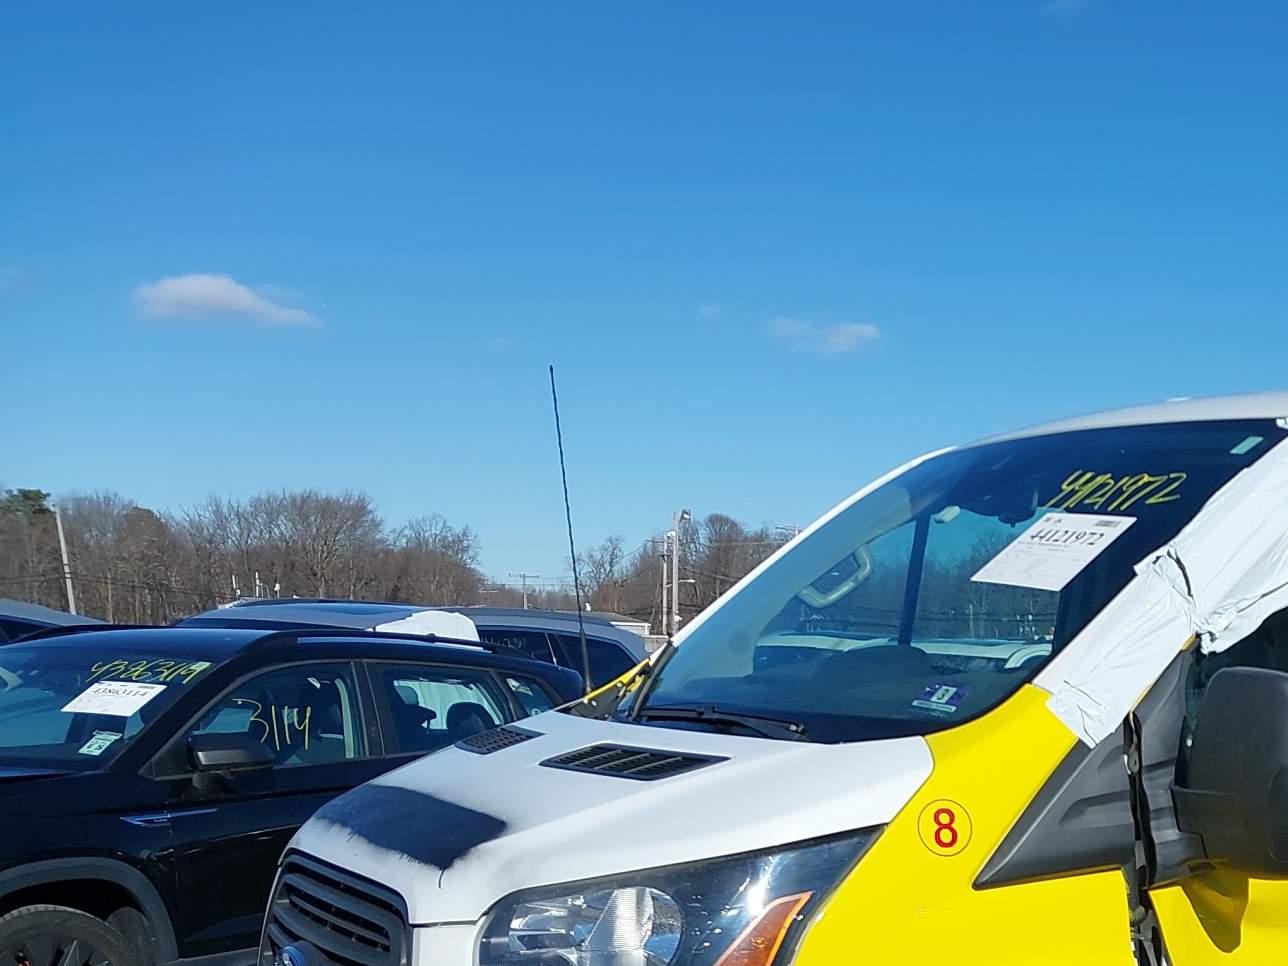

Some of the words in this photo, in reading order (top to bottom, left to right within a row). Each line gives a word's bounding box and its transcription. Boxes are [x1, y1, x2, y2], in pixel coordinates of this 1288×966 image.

[1030, 528, 1105, 546] 44121972
[231, 698, 312, 751] 3114
[933, 808, 958, 848] 8
